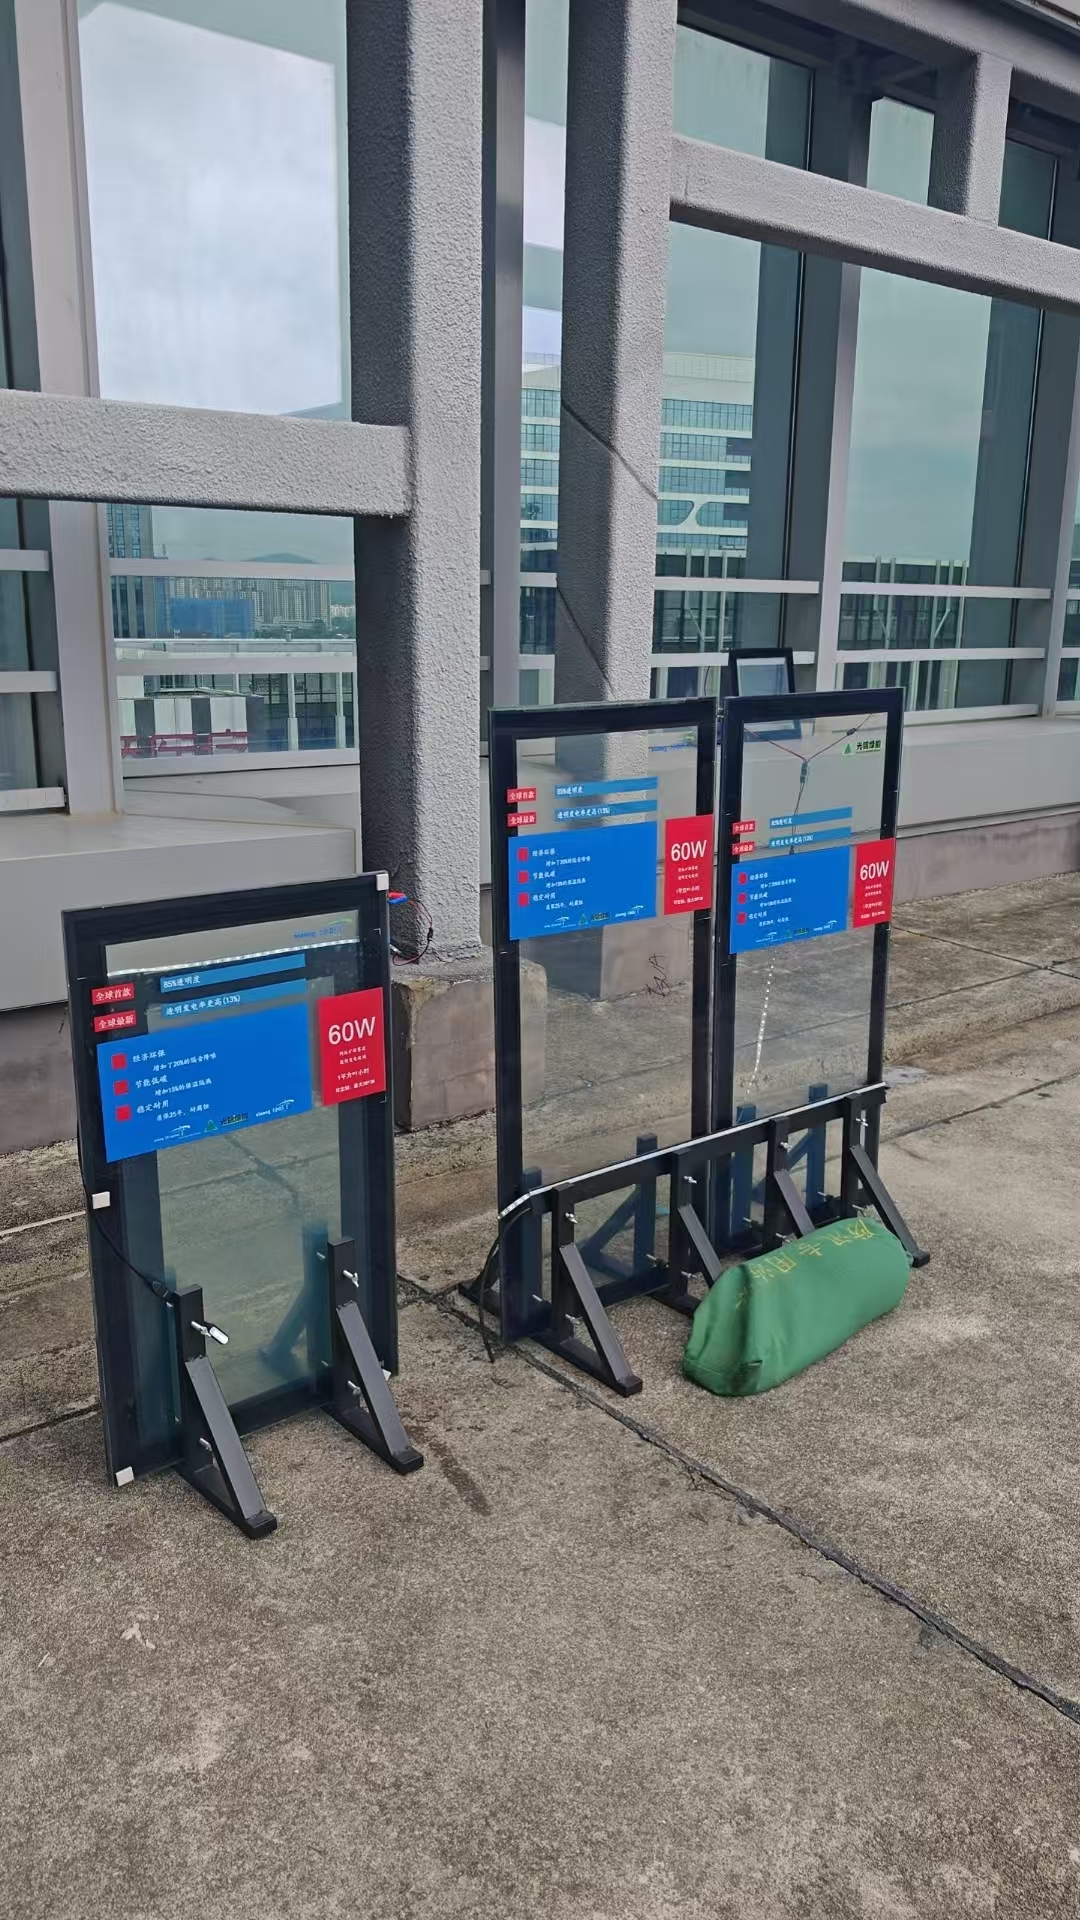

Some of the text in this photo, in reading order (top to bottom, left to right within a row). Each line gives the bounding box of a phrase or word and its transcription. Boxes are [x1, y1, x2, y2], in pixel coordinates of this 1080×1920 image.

[671, 839, 707, 862] 60W
[860, 860, 890, 881] 60W
[95, 987, 132, 1002] 全球首款
[98, 1014, 134, 1029] 全球最新
[328, 1016, 376, 1045] 60W
[132, 1049, 166, 1063] 经济环保
